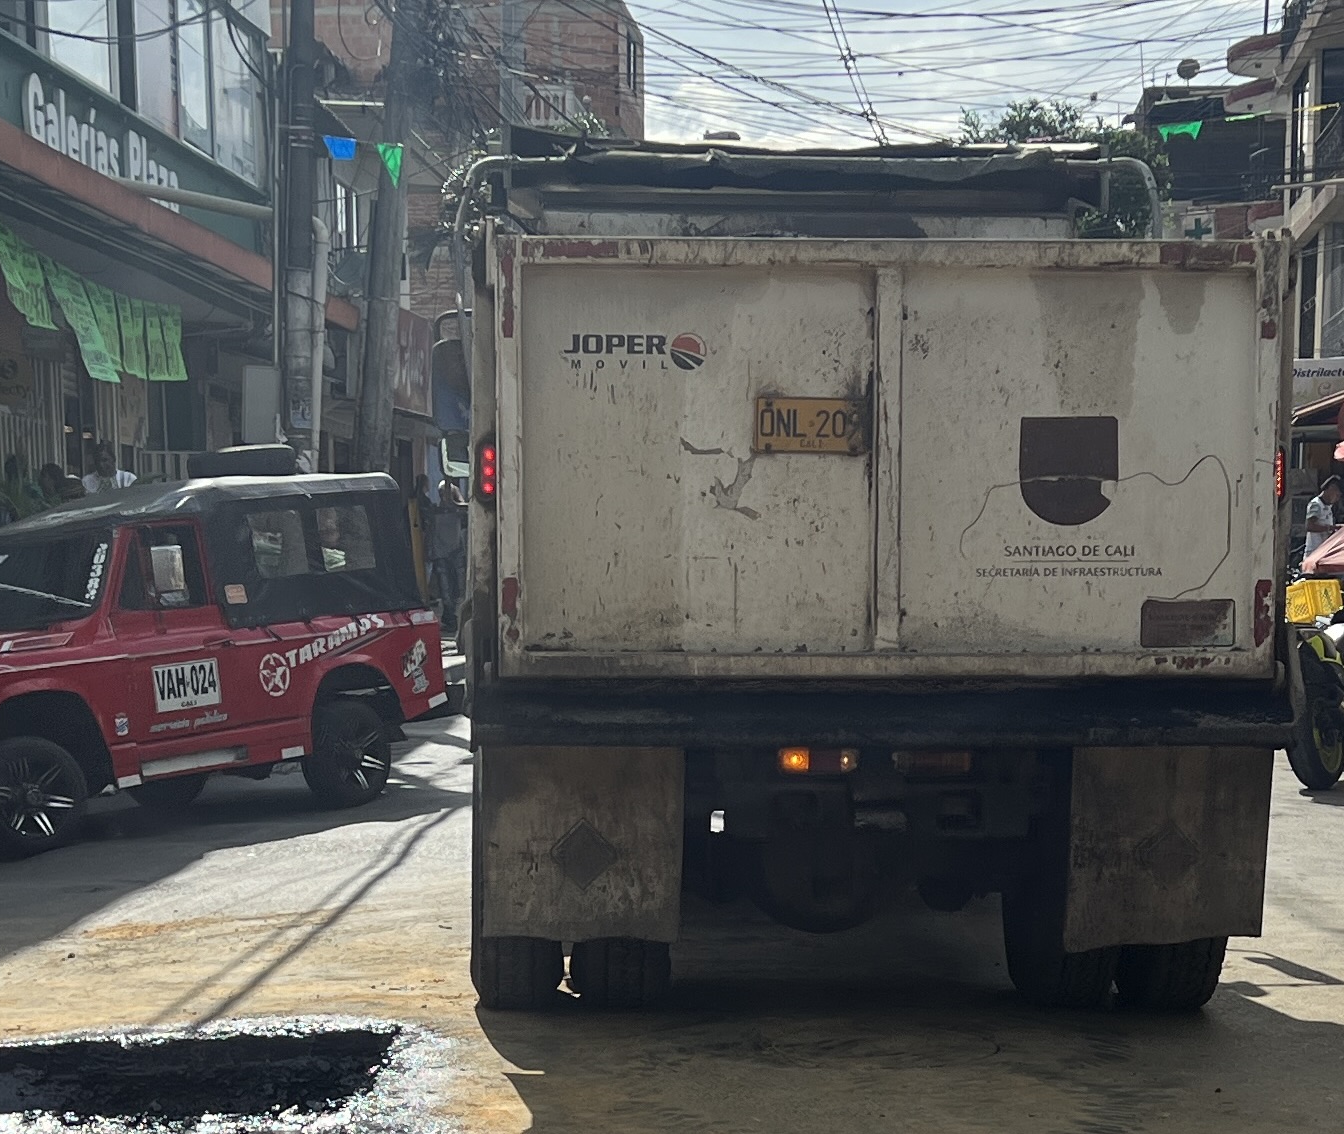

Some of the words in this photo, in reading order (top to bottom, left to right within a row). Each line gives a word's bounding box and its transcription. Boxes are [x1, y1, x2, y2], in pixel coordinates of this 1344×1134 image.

[22, 73, 120, 178] Galerías
[124, 129, 180, 214] Plaza
[564, 334, 667, 355] JOPER
[760, 408, 806, 438] ONL
[1004, 545, 1077, 557] SANTIAGO
[1082, 545, 1100, 556] DE
[1105, 545, 1135, 557] CALI
[1044, 568, 1057, 577] DE
[1061, 567, 1162, 577] INFRAESTRUCTURA
